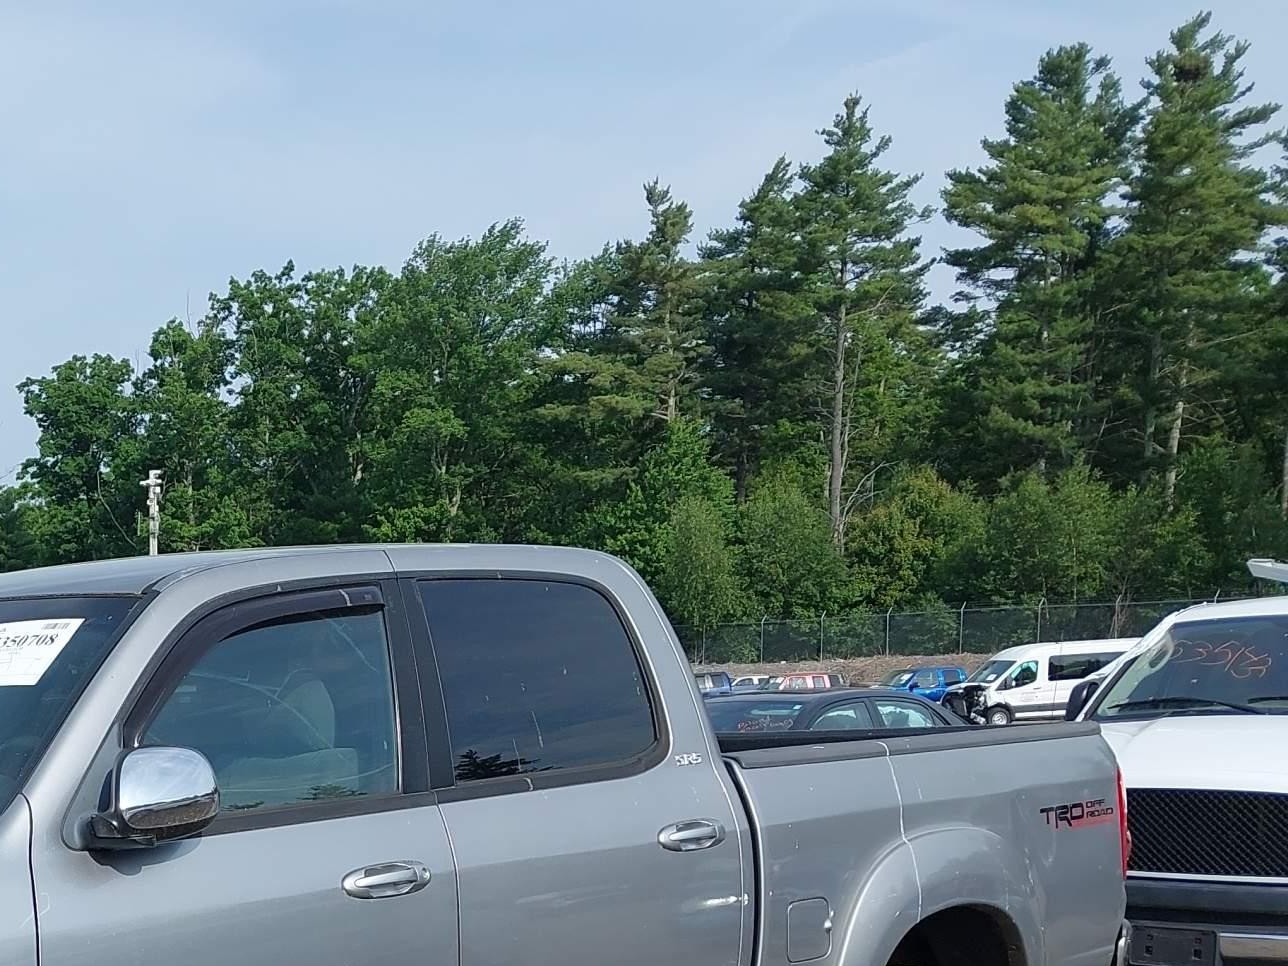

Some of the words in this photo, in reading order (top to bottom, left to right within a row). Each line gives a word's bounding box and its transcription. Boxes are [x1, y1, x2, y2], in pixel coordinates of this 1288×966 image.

[1086, 799, 1105, 809] OFF
[1039, 802, 1085, 829] TRD
[1086, 807, 1114, 819] ROAD
